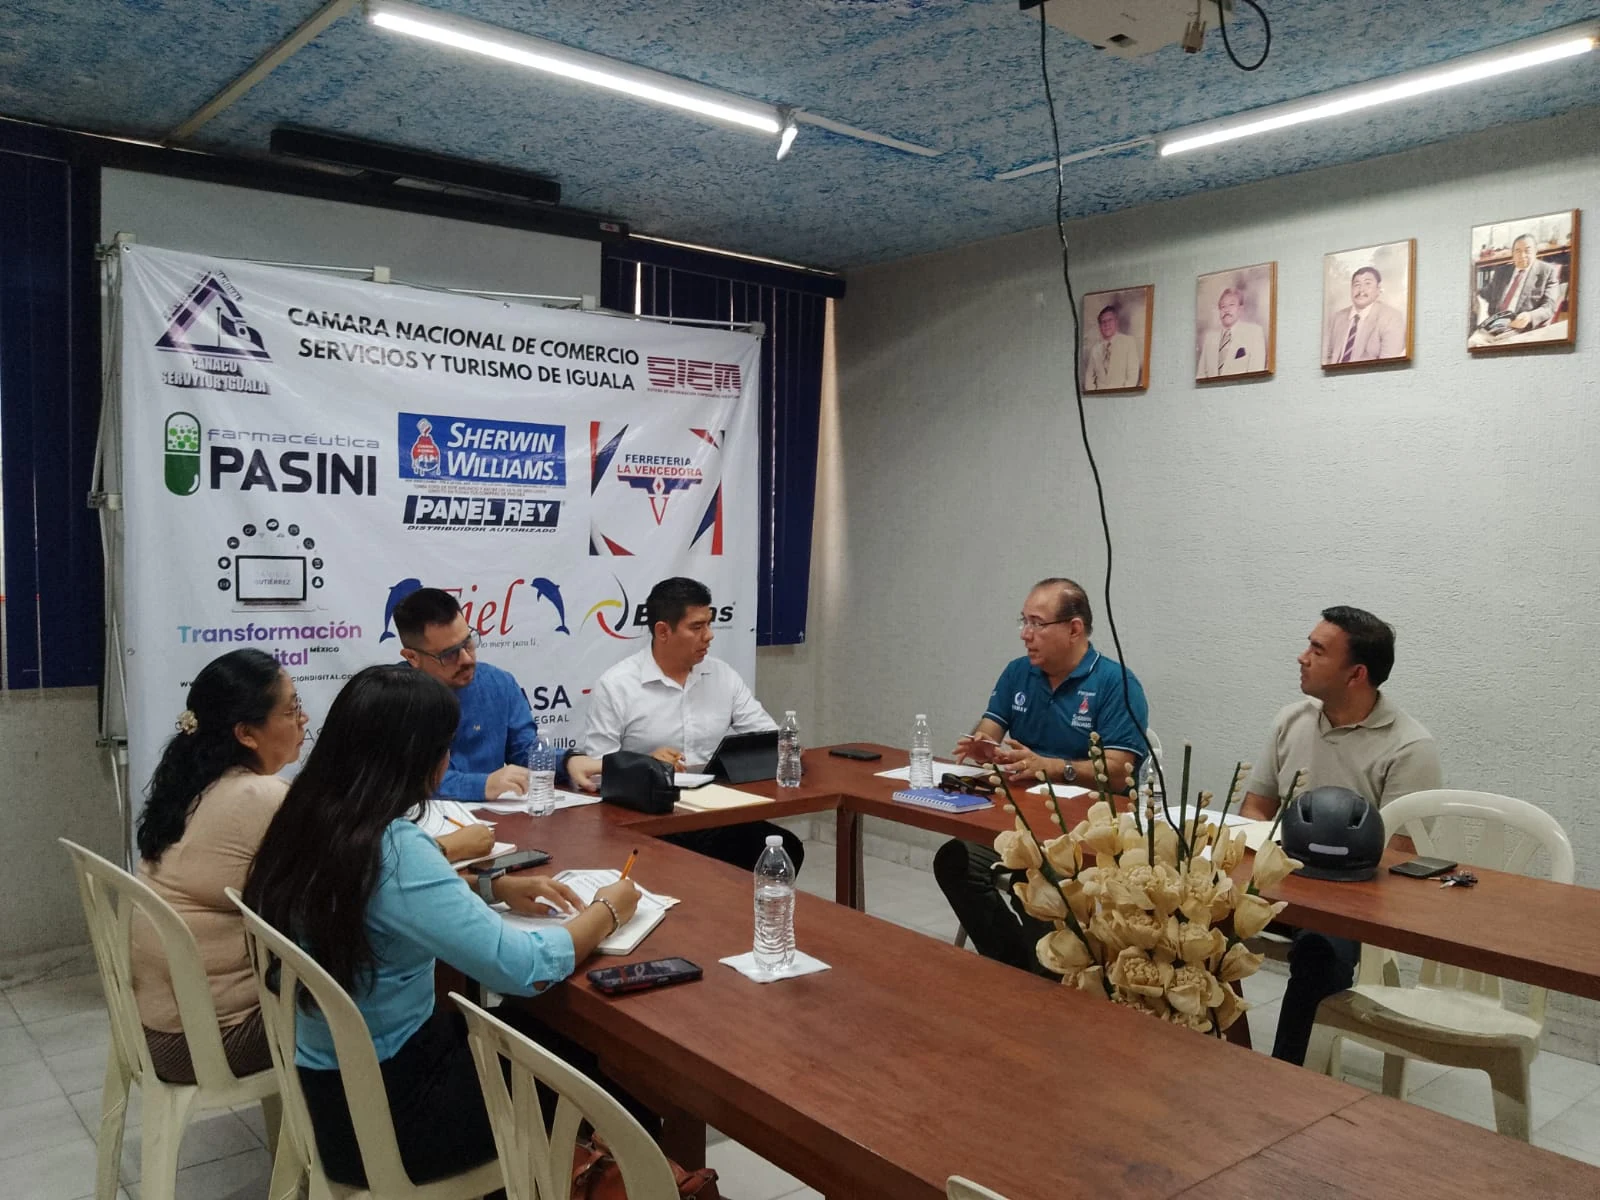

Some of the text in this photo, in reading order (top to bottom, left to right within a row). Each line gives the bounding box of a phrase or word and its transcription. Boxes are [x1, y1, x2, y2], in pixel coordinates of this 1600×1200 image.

[396, 321, 506, 352] NACIONAL
[512, 336, 536, 355] DE
[540, 340, 639, 366] COMERCIO
[298, 338, 635, 391] SERVICIOS Y TURISMO DE IGUALA
[223, 377, 269, 395] IGUALA
[207, 428, 380, 449] farmacéutica
[447, 422, 556, 453] SHERWIN
[210, 445, 377, 497] PASINI
[617, 464, 703, 476] LA VENCEDORA
[414, 498, 553, 522] PANEL REY
[177, 620, 362, 644] Transformación
